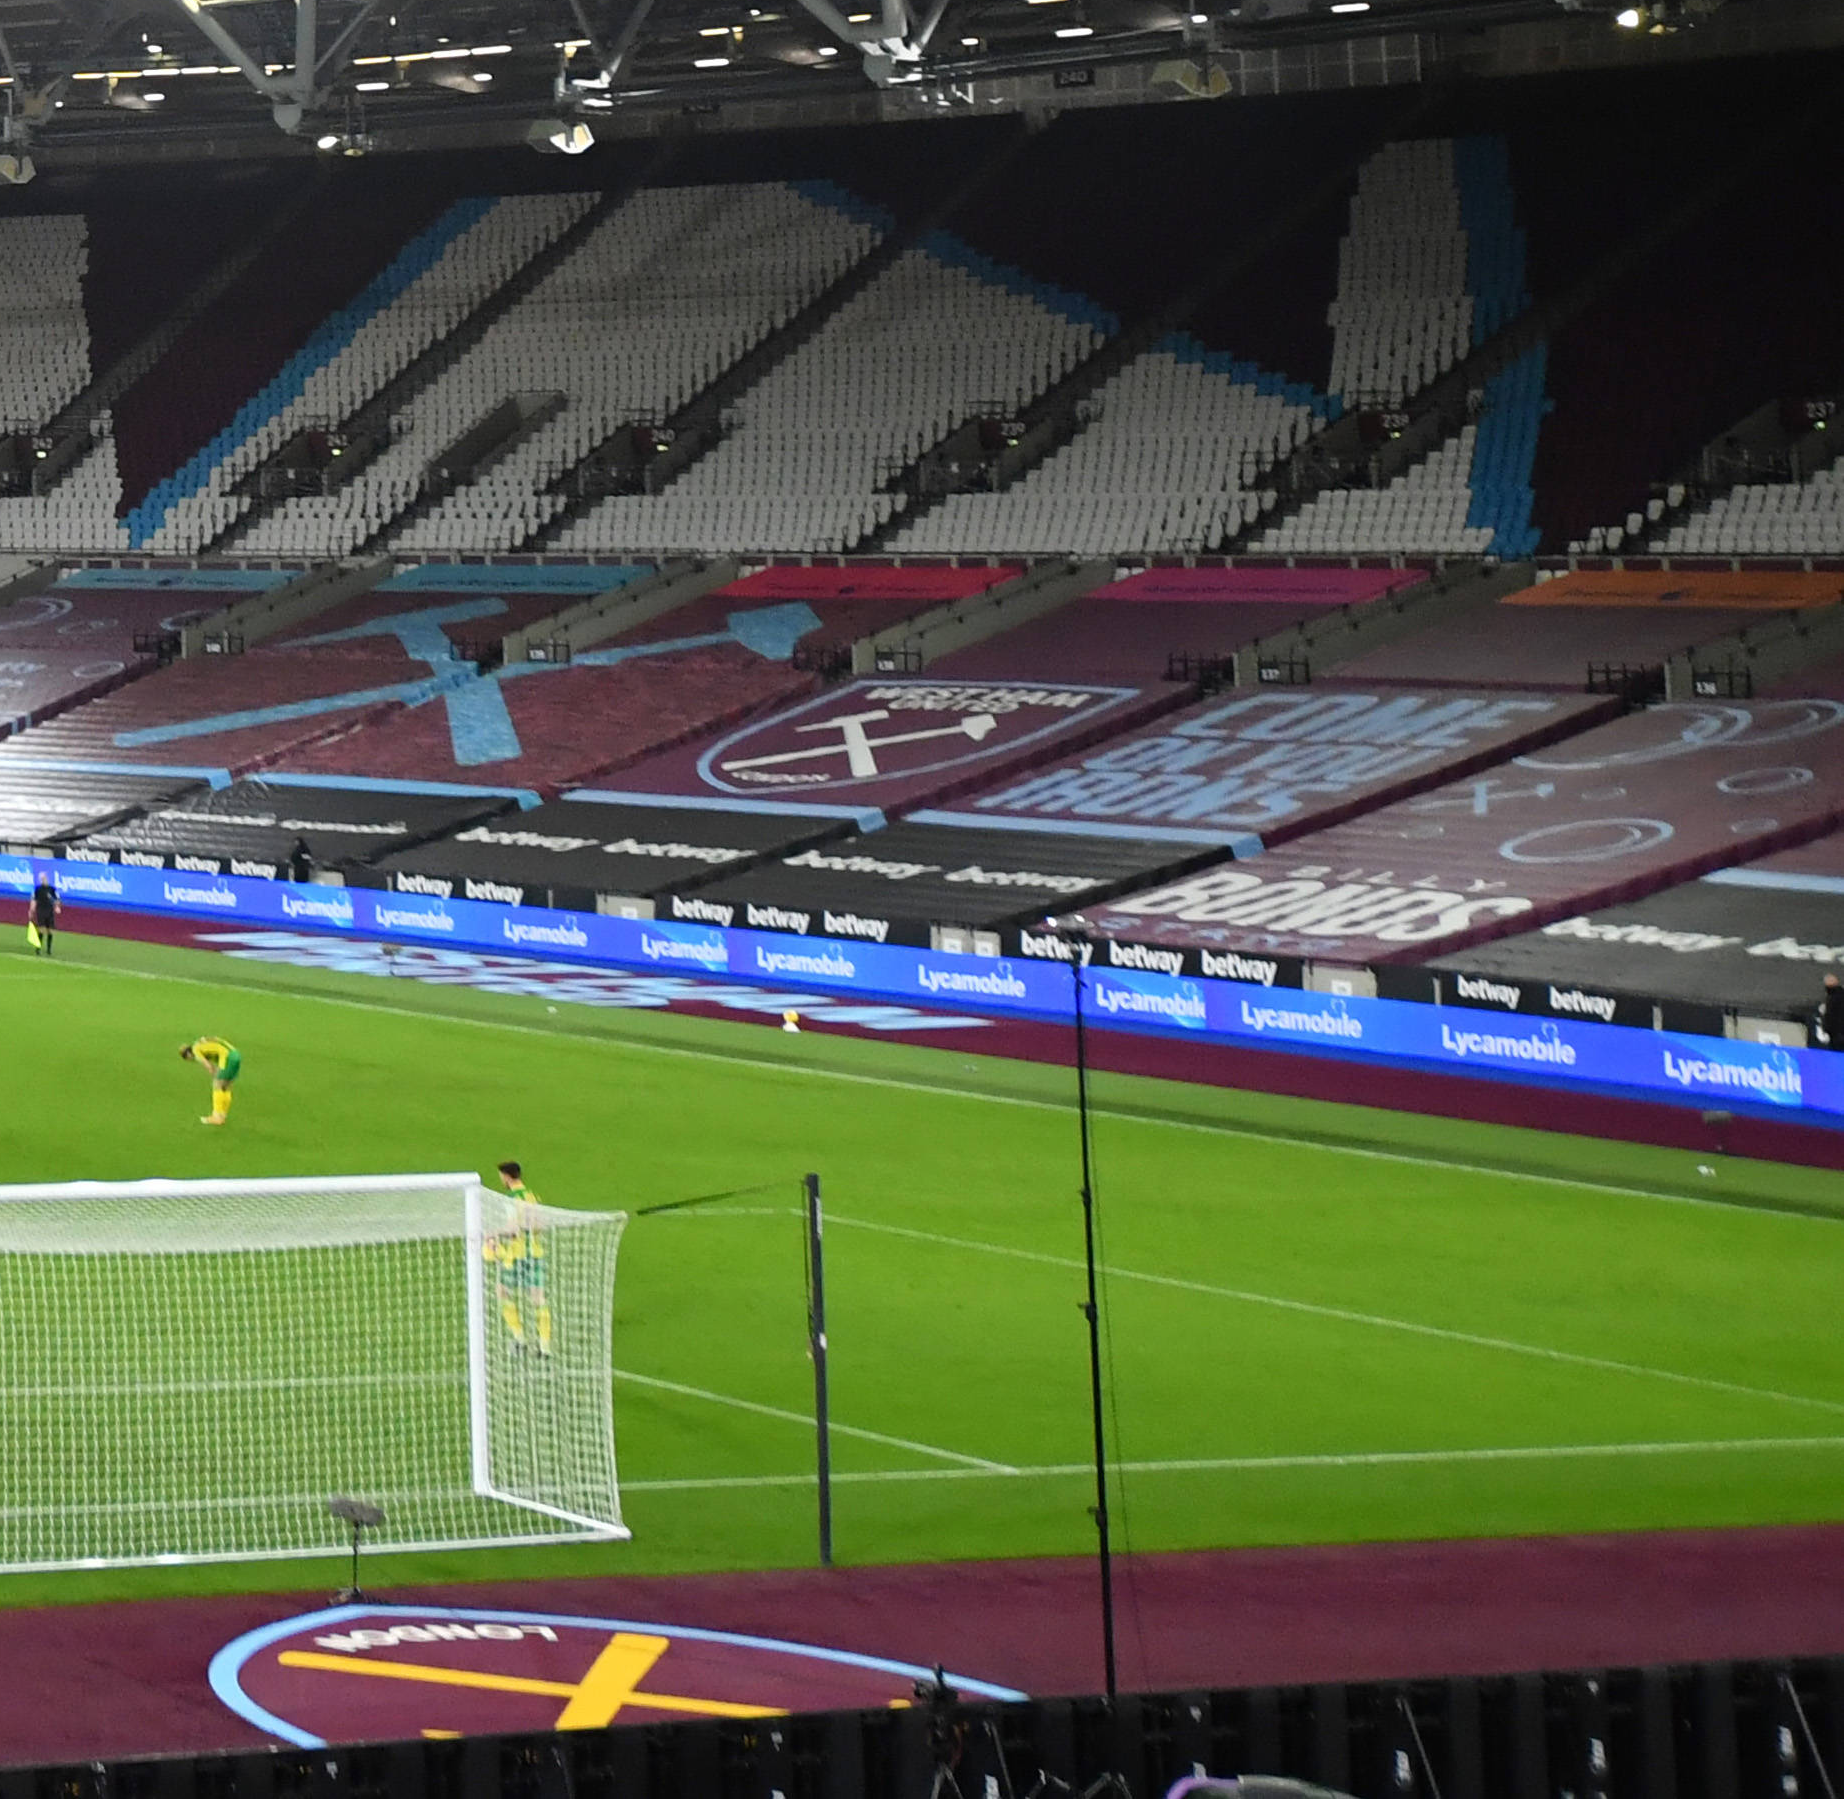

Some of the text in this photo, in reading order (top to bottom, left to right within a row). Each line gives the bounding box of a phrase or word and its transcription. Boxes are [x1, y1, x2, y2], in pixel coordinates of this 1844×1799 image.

[32, 438, 53, 449] 242
[1171, 692, 1557, 748] COME
[1082, 735, 1445, 785] ON YOU
[974, 767, 1356, 826] IRONS
[454, 826, 600, 853] betway
[603, 838, 759, 865] betway
[66, 846, 111, 866] betway
[120, 849, 165, 870] betway
[175, 853, 221, 875] betway
[231, 858, 277, 881] betway
[782, 849, 943, 880] betway
[54, 871, 123, 895] Lycamobile
[396, 871, 453, 899] betway
[465, 877, 524, 907] betway
[944, 865, 1111, 894] betway
[1285, 865, 1509, 893] BILLY
[164, 882, 237, 908] Lycamobile
[1106, 870, 1535, 942] BONDS
[375, 904, 454, 932] Lycamobile
[672, 895, 734, 927] betway
[747, 903, 811, 935] betway
[823, 910, 890, 943] betway
[503, 918, 589, 949] Lycamobile
[1541, 915, 1744, 953] betway
[757, 946, 856, 978] Lycamobile
[1109, 939, 1185, 976] betway
[1201, 949, 1278, 987] betway
[918, 963, 1026, 999] Lycamobile
[1456, 974, 1521, 1009] betway
[1549, 985, 1617, 1022] betway
[1242, 1000, 1363, 1040] Lycamobile
[1442, 1023, 1577, 1066] Lycamobile
[313, 1623, 560, 1654] LONDON
